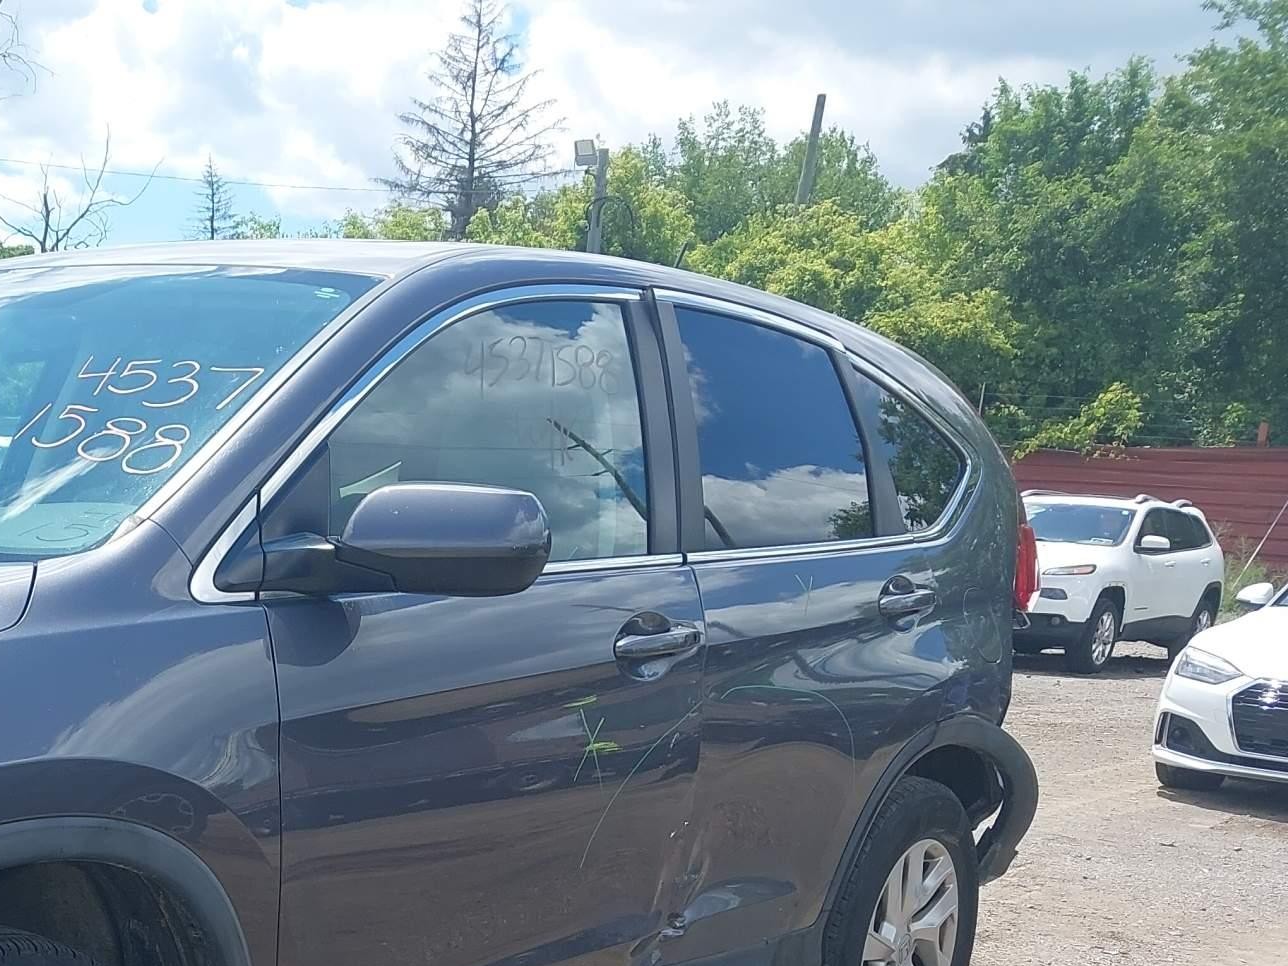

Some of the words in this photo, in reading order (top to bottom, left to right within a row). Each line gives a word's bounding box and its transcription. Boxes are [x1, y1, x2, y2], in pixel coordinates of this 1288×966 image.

[77, 353, 266, 411] 4537
[463, 335, 620, 399] 45371588
[13, 402, 191, 475] 1588
